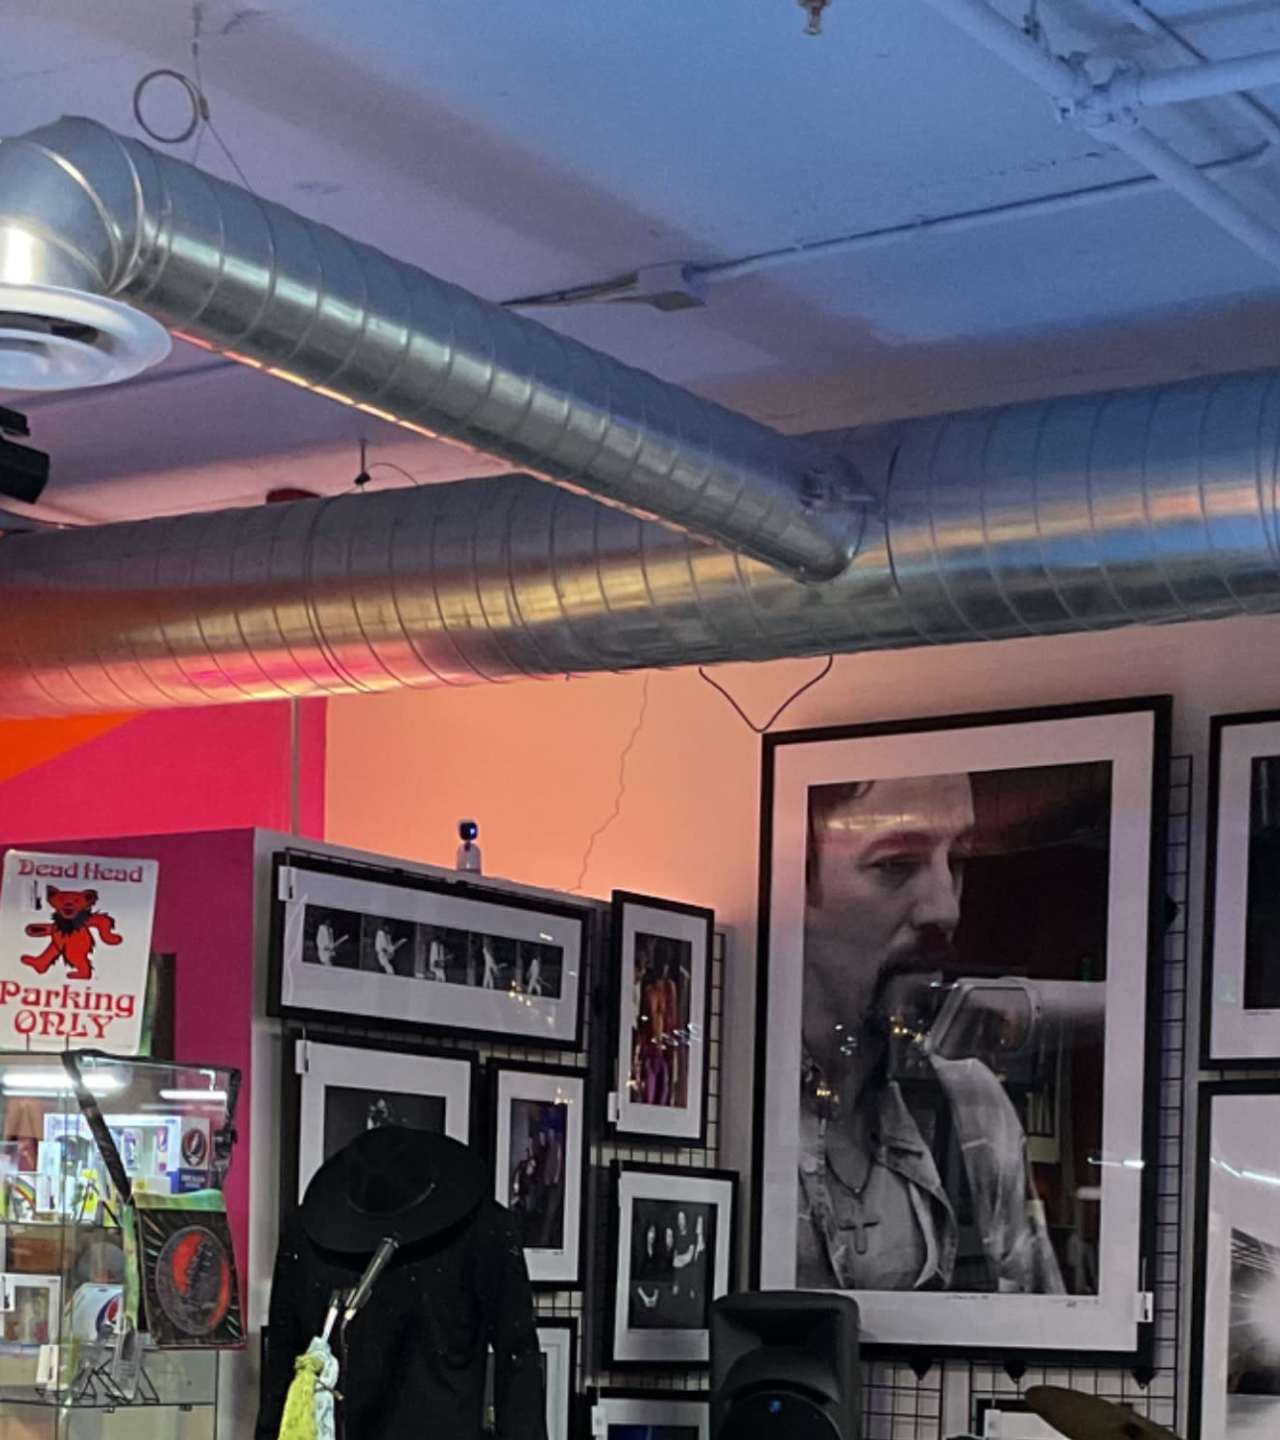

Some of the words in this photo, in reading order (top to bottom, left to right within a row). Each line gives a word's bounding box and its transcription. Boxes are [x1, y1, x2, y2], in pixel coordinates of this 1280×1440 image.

[18, 859, 79, 879] Dead
[83, 863, 143, 882] Head
[15, 1009, 113, 1038] ONLY
